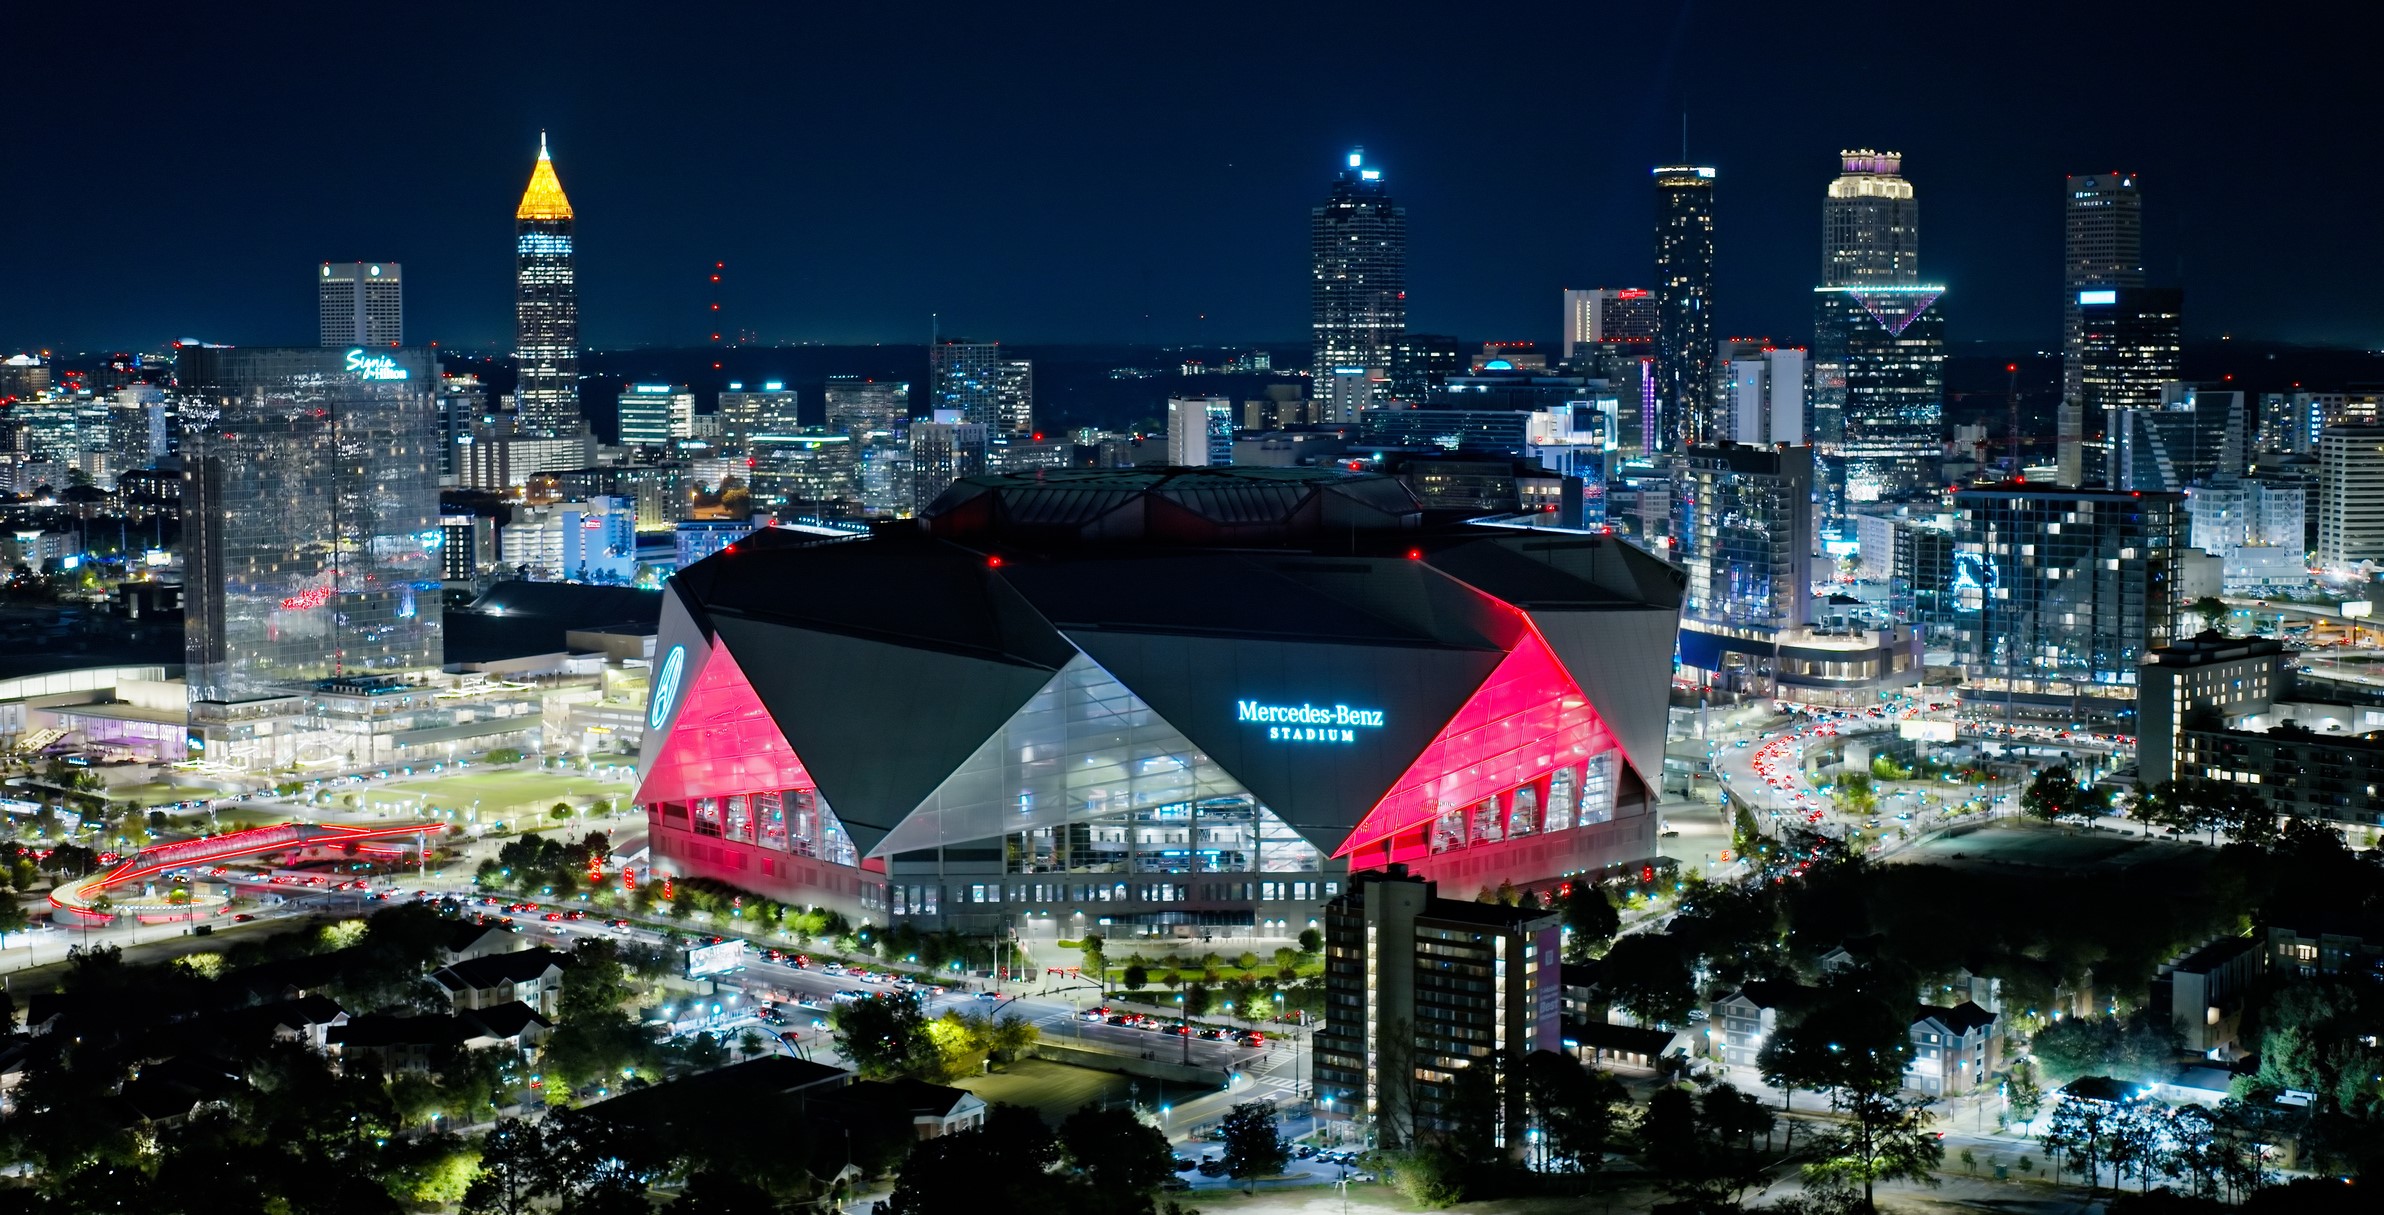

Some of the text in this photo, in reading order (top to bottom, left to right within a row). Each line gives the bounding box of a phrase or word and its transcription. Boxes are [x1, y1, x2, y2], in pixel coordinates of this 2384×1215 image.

[346, 349, 396, 380] Signia
[375, 367, 407, 380] Hilton
[1238, 700, 1383, 726] Mercedes-Benz
[1270, 727, 1353, 741] STADIUM
[1540, 999, 1559, 1014] Best
